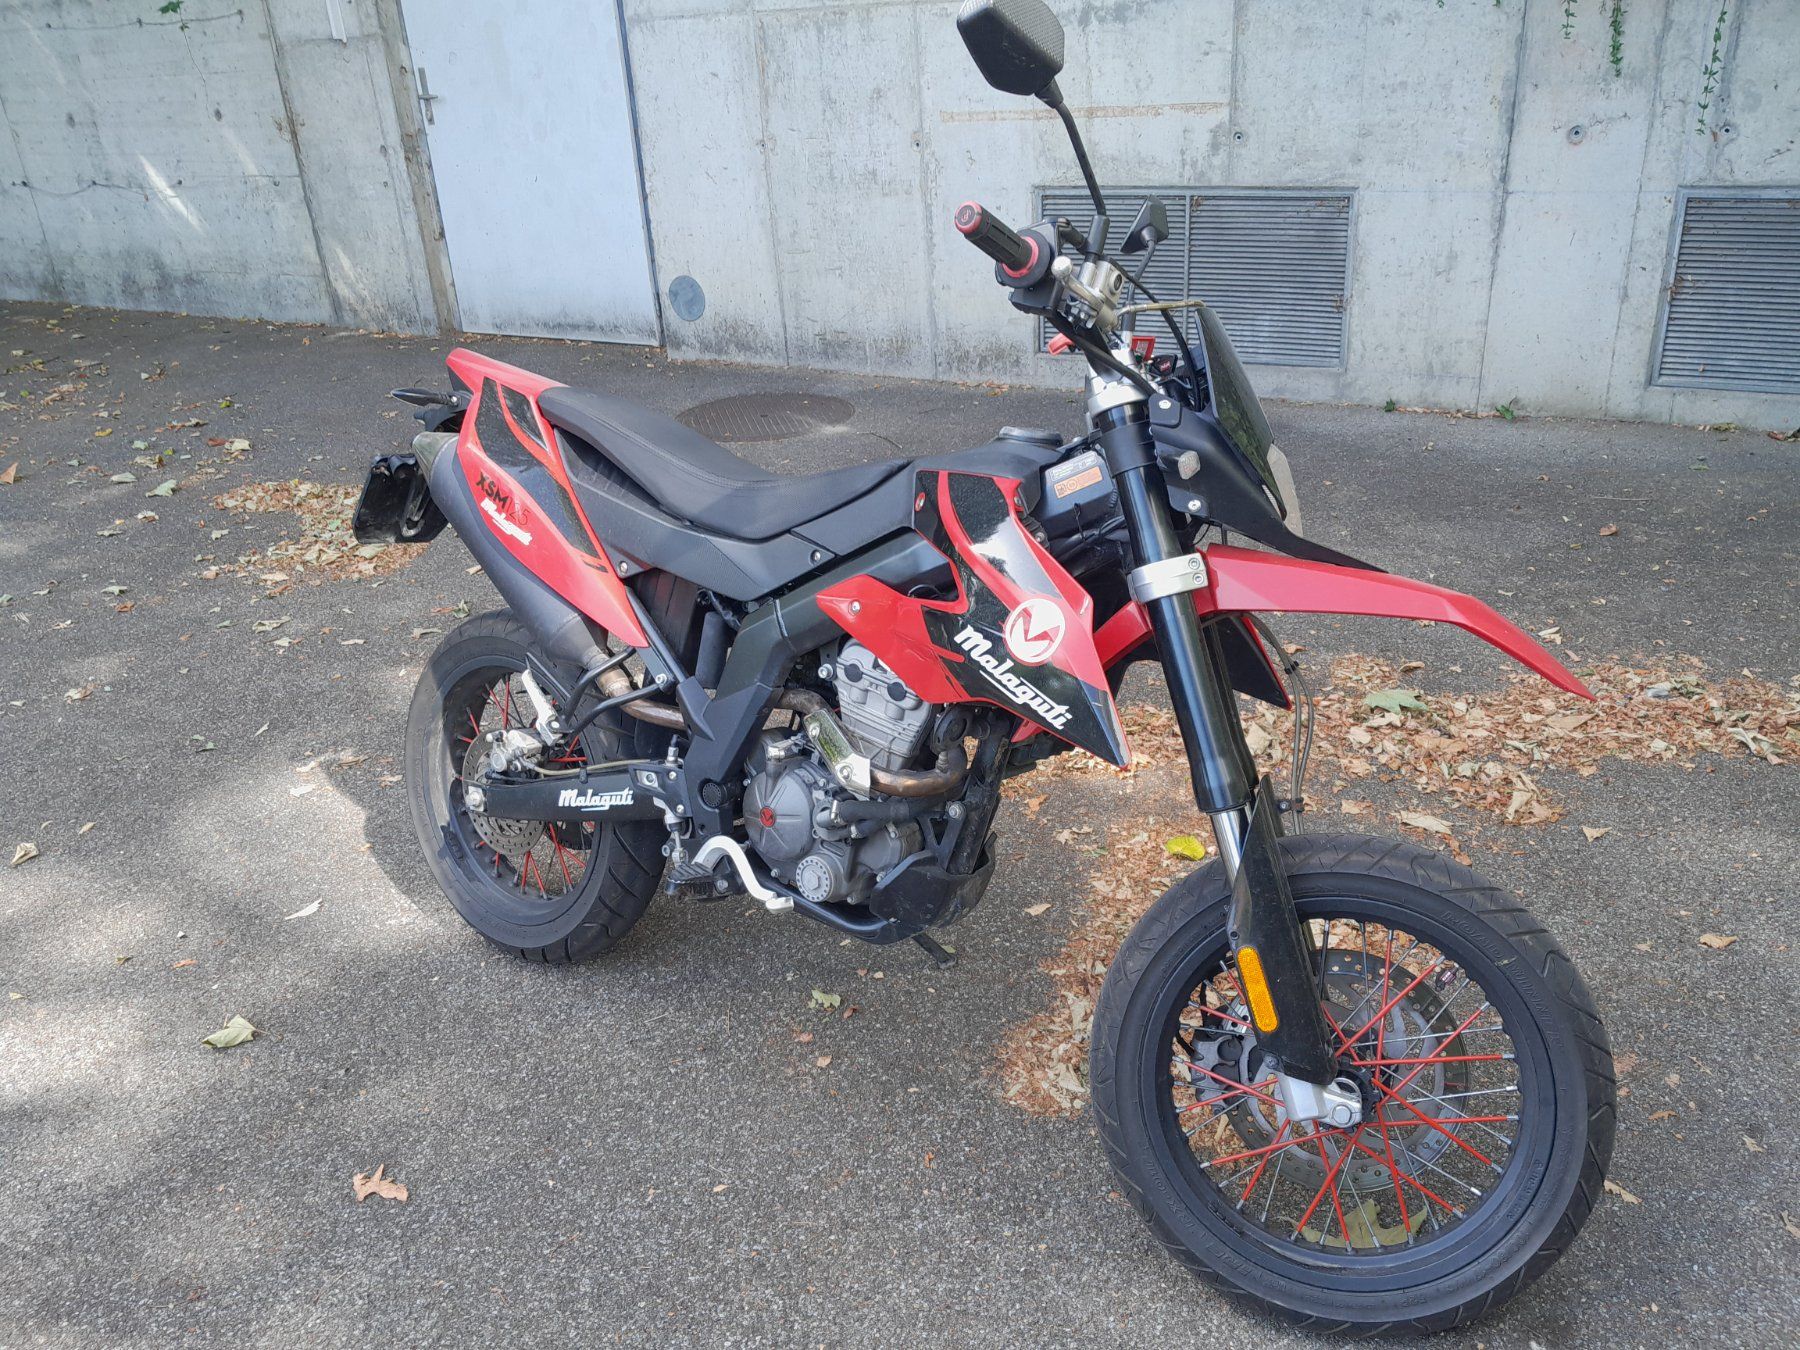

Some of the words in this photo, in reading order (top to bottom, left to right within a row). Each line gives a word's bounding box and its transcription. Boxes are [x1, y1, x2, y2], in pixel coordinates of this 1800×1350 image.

[476, 472, 508, 509] XSM
[953, 624, 1072, 730] Malaguti
[558, 787, 634, 811] Malaguti
